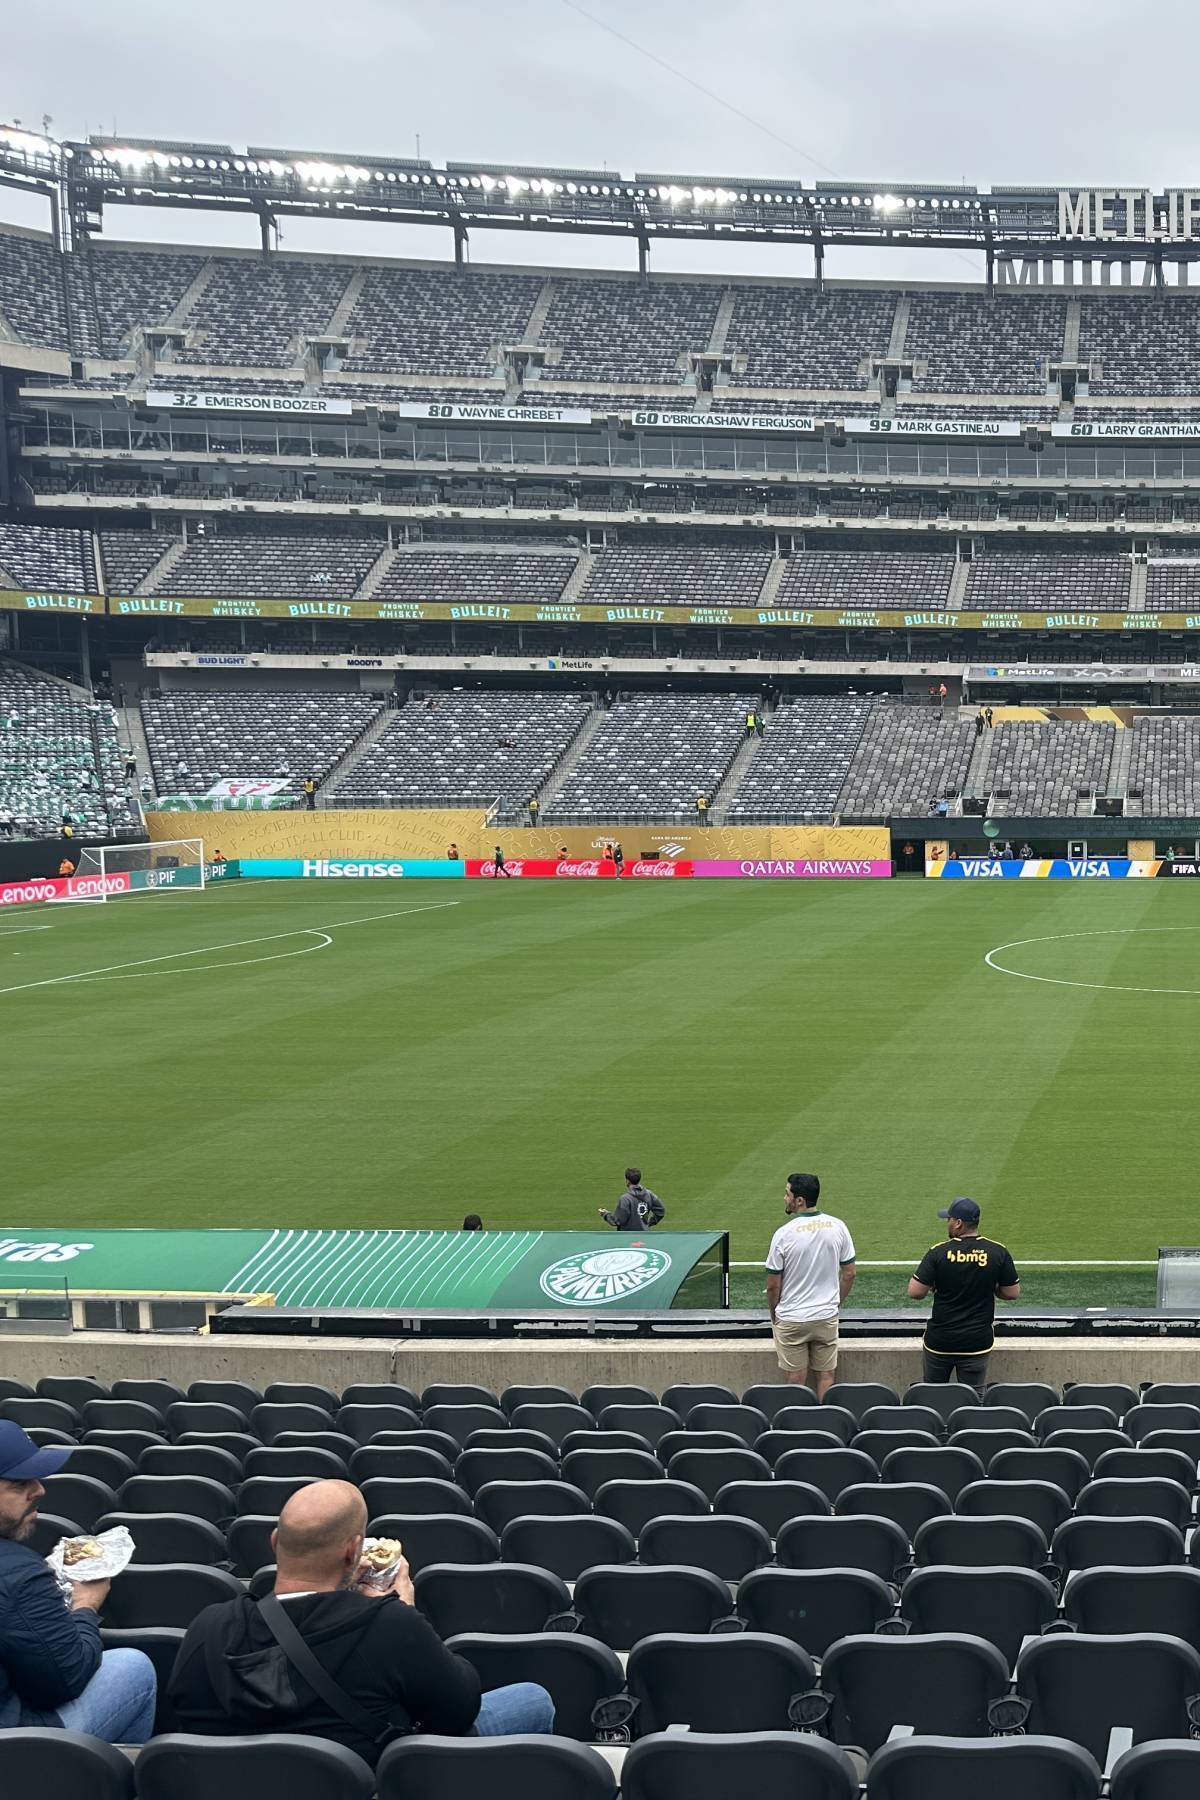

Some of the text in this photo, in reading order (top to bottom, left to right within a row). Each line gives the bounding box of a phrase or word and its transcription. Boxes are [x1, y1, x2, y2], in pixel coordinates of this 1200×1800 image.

[172, 394, 327, 411] 32 EMERSON BOOZER
[428, 405, 563, 420] 80 WAYNE CHREBET
[635, 412, 812, 429] 60 D'BRICKASHAW FERGUSON
[869, 420, 999, 434] 99 MARK GASTINEAU
[1071, 424, 1093, 436] 60
[1098, 425, 1137, 435] LARRY
[212, 607, 261, 616] WHISKEY
[378, 610, 425, 619] WHISKEY
[536, 612, 581, 621] WHISKEY
[689, 615, 733, 624] WHISKEY
[838, 618, 880, 626] WHISKEY
[981, 620, 1022, 628] WHISKEY
[1122, 620, 1162, 628] WHISKEY
[198, 657, 245, 665] BUD LIGHT
[347, 658, 382, 667] MOODY'S
[561, 660, 593, 669] MetLife
[212, 865, 227, 877] PIF
[303, 860, 404, 877] Hisense
[480, 861, 525, 877] CocCola
[556, 861, 601, 877] Coca-Cola
[632, 861, 675, 877] Coca-Cola
[740, 861, 872, 876] QATAR AIRWAYS
[958, 861, 1004, 877] VISA
[1065, 861, 1110, 877] VISA
[1172, 864, 1194, 874] FIFA
[158, 871, 176, 884] PIF
[0, 884, 56, 903] enovo
[68, 878, 126, 896] Lenovo
[796, 1220, 833, 1233] crefisa
[956, 1250, 988, 1267] bmg
[550, 1264, 661, 1301] PALMEIRAS
